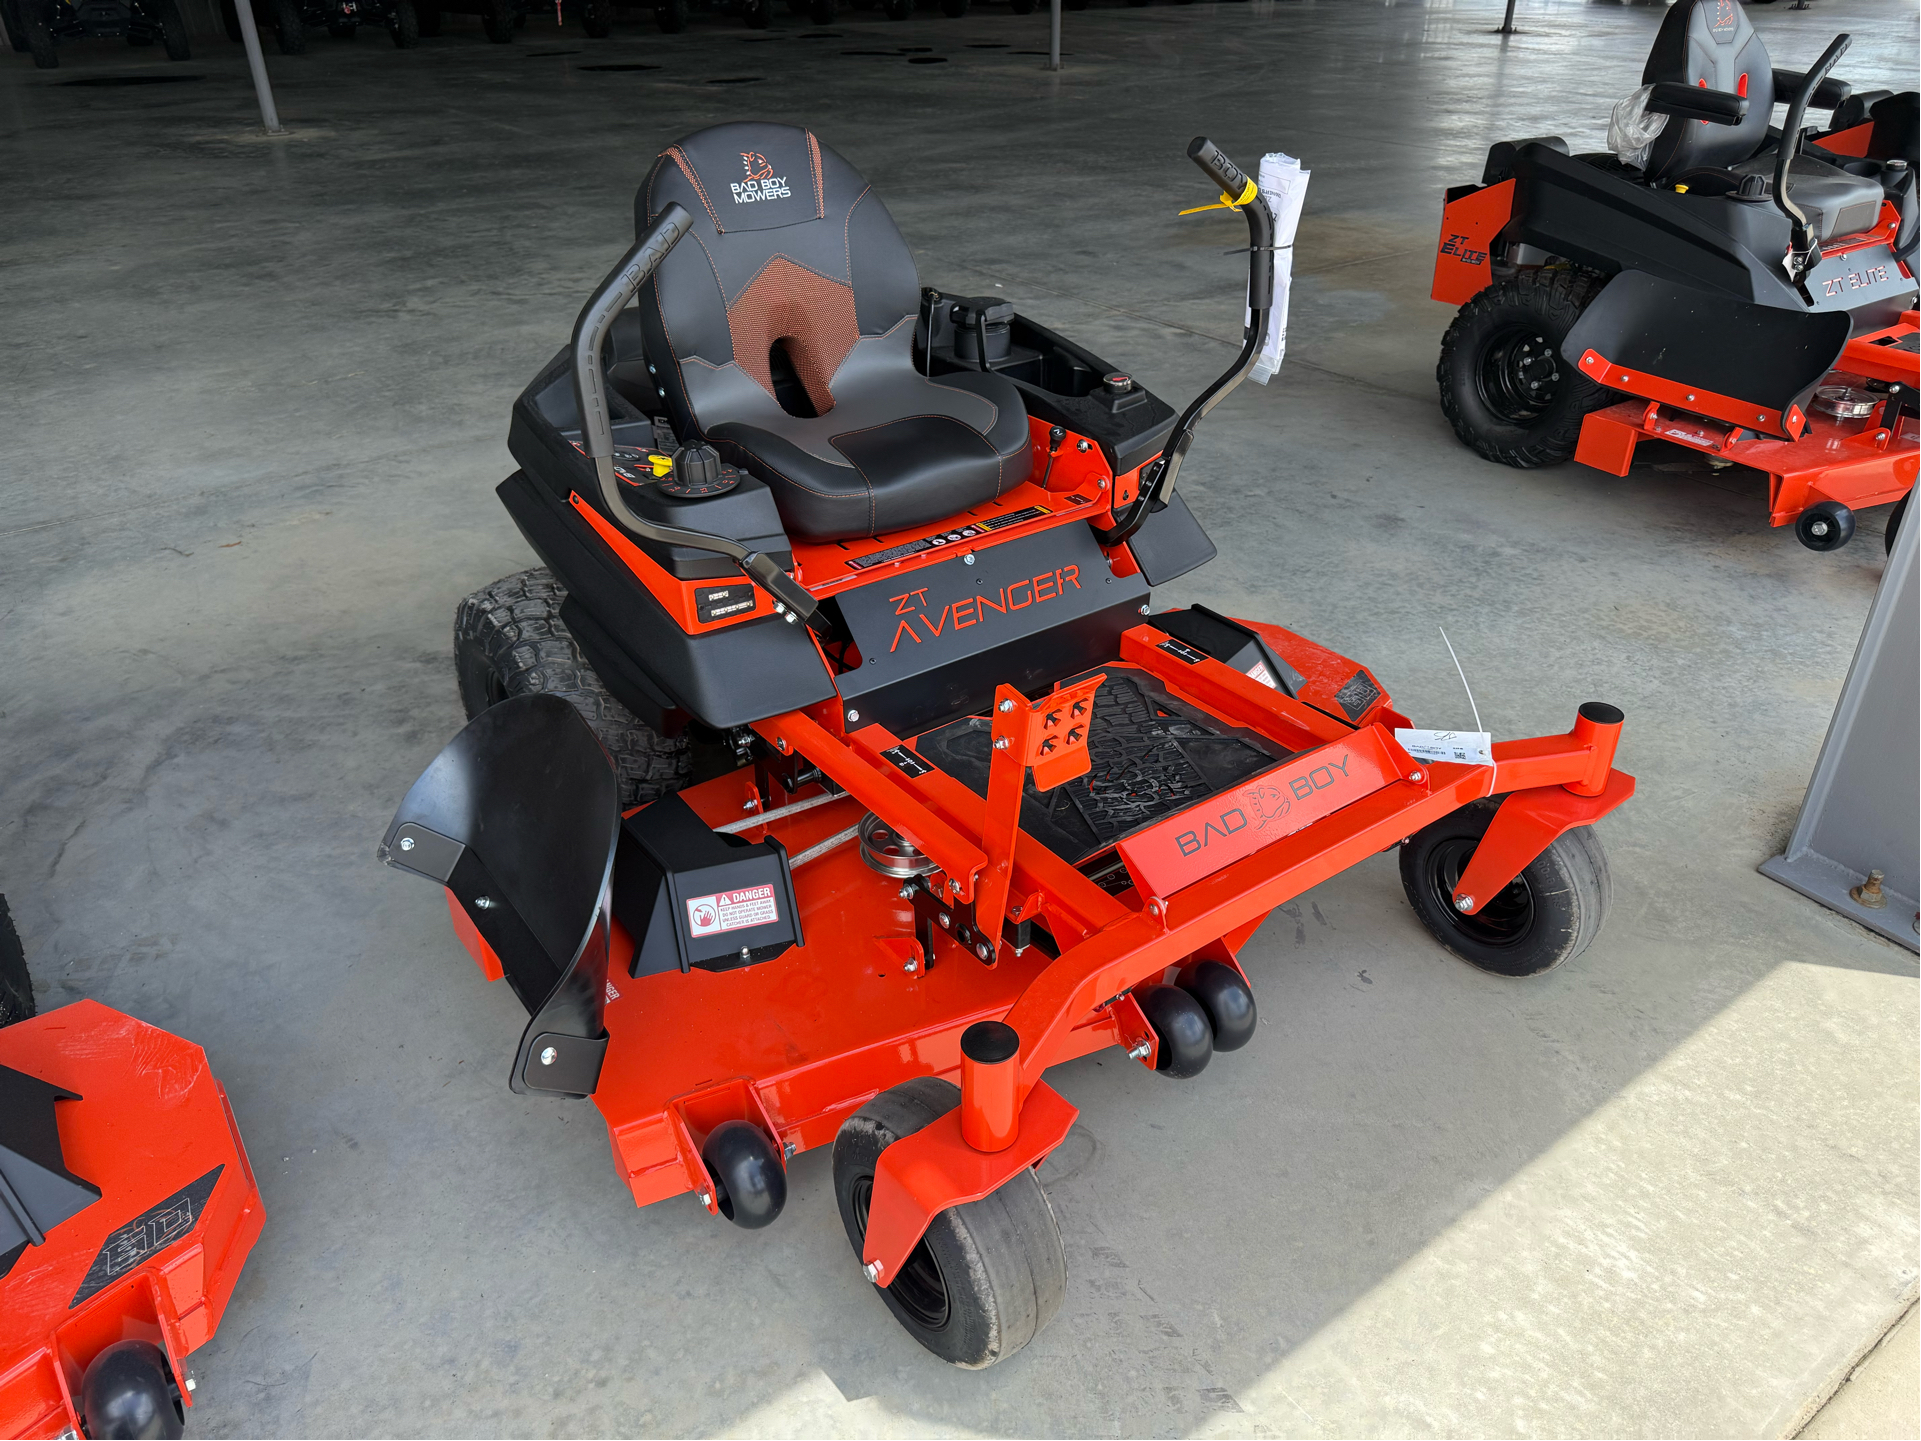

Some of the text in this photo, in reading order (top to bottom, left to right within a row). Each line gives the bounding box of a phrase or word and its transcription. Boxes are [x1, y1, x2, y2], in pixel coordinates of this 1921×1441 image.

[730, 176, 787, 193] BAD BOY
[733, 186, 792, 204] MOWERS
[1448, 234, 1469, 245] ZT
[620, 222, 680, 293] BAD
[1440, 242, 1488, 261] ELITE
[1822, 265, 1889, 297] ZT ELITE
[889, 587, 929, 615] ZT
[890, 564, 1082, 653] AVENGER
[1175, 754, 1350, 857] BAD BOY
[732, 887, 771, 903] DANGER
[726, 920, 745, 928] CATCHER
[605, 979, 620, 1000] NGER
